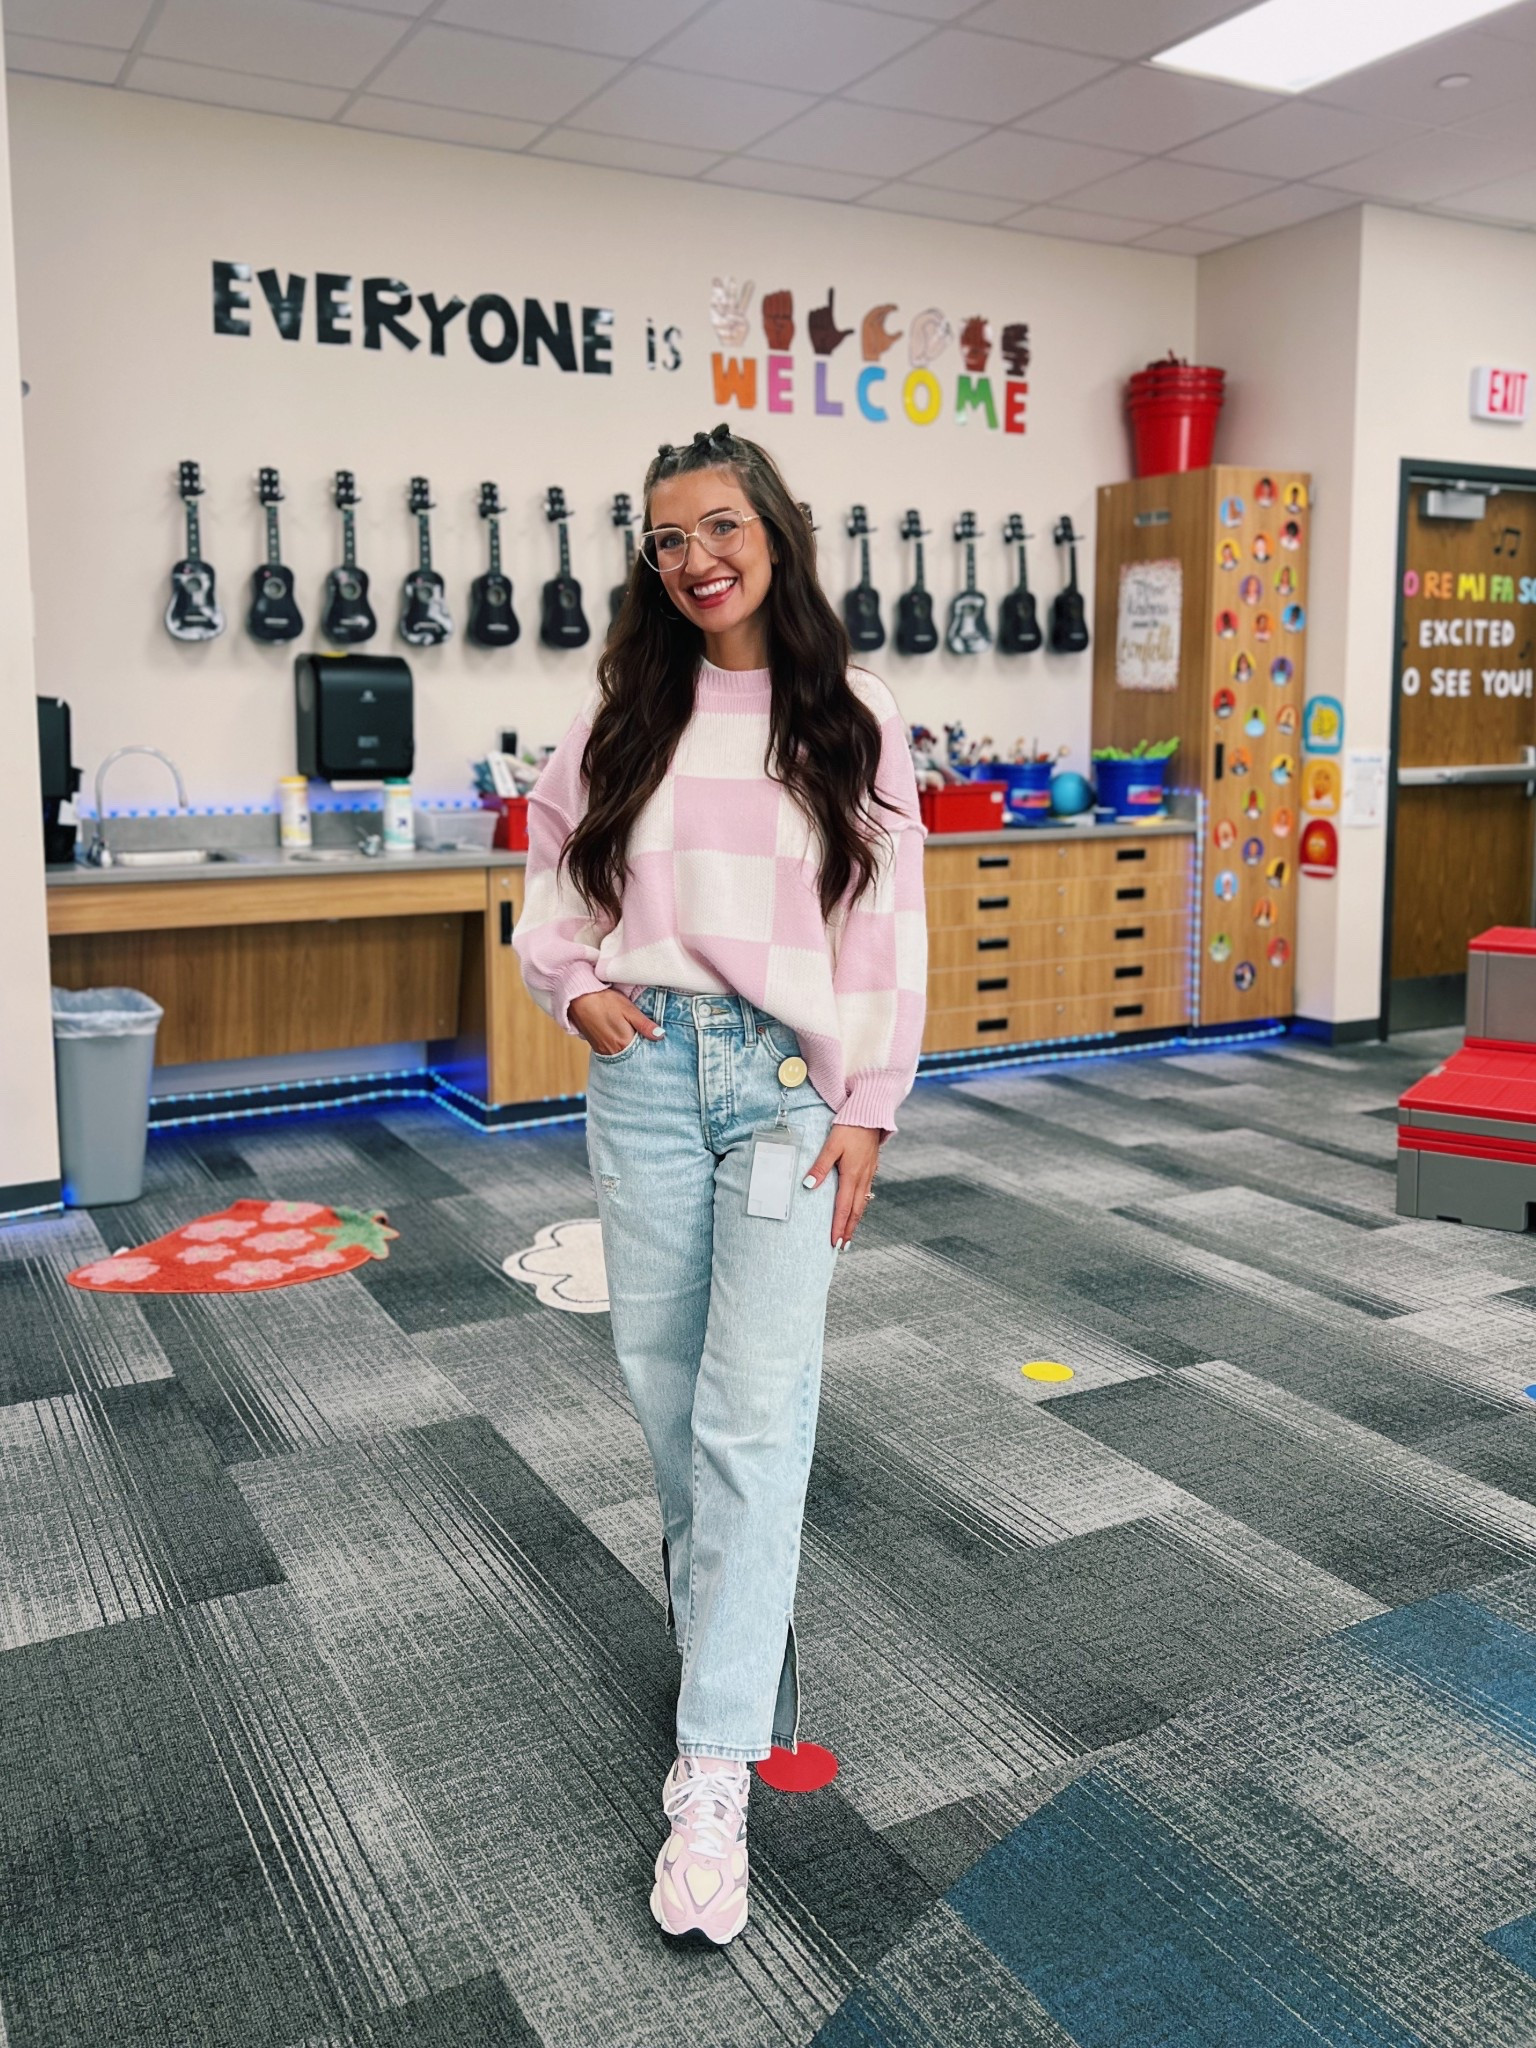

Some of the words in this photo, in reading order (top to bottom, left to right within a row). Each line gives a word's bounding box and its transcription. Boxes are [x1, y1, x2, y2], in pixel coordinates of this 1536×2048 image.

[212, 260, 614, 375] EVERYONE
[646, 316, 683, 372] is
[711, 352, 1030, 434] WELCOME
[1488, 369, 1528, 416] EXIT
[1403, 570, 1420, 598] O
[1424, 571, 1453, 600] RE
[1457, 573, 1486, 602] MI
[1491, 574, 1515, 603] FA
[1419, 618, 1516, 648] EXCITED
[1402, 667, 1420, 697] O
[1430, 667, 1471, 697] SEE
[1481, 668, 1534, 699] YOU!
